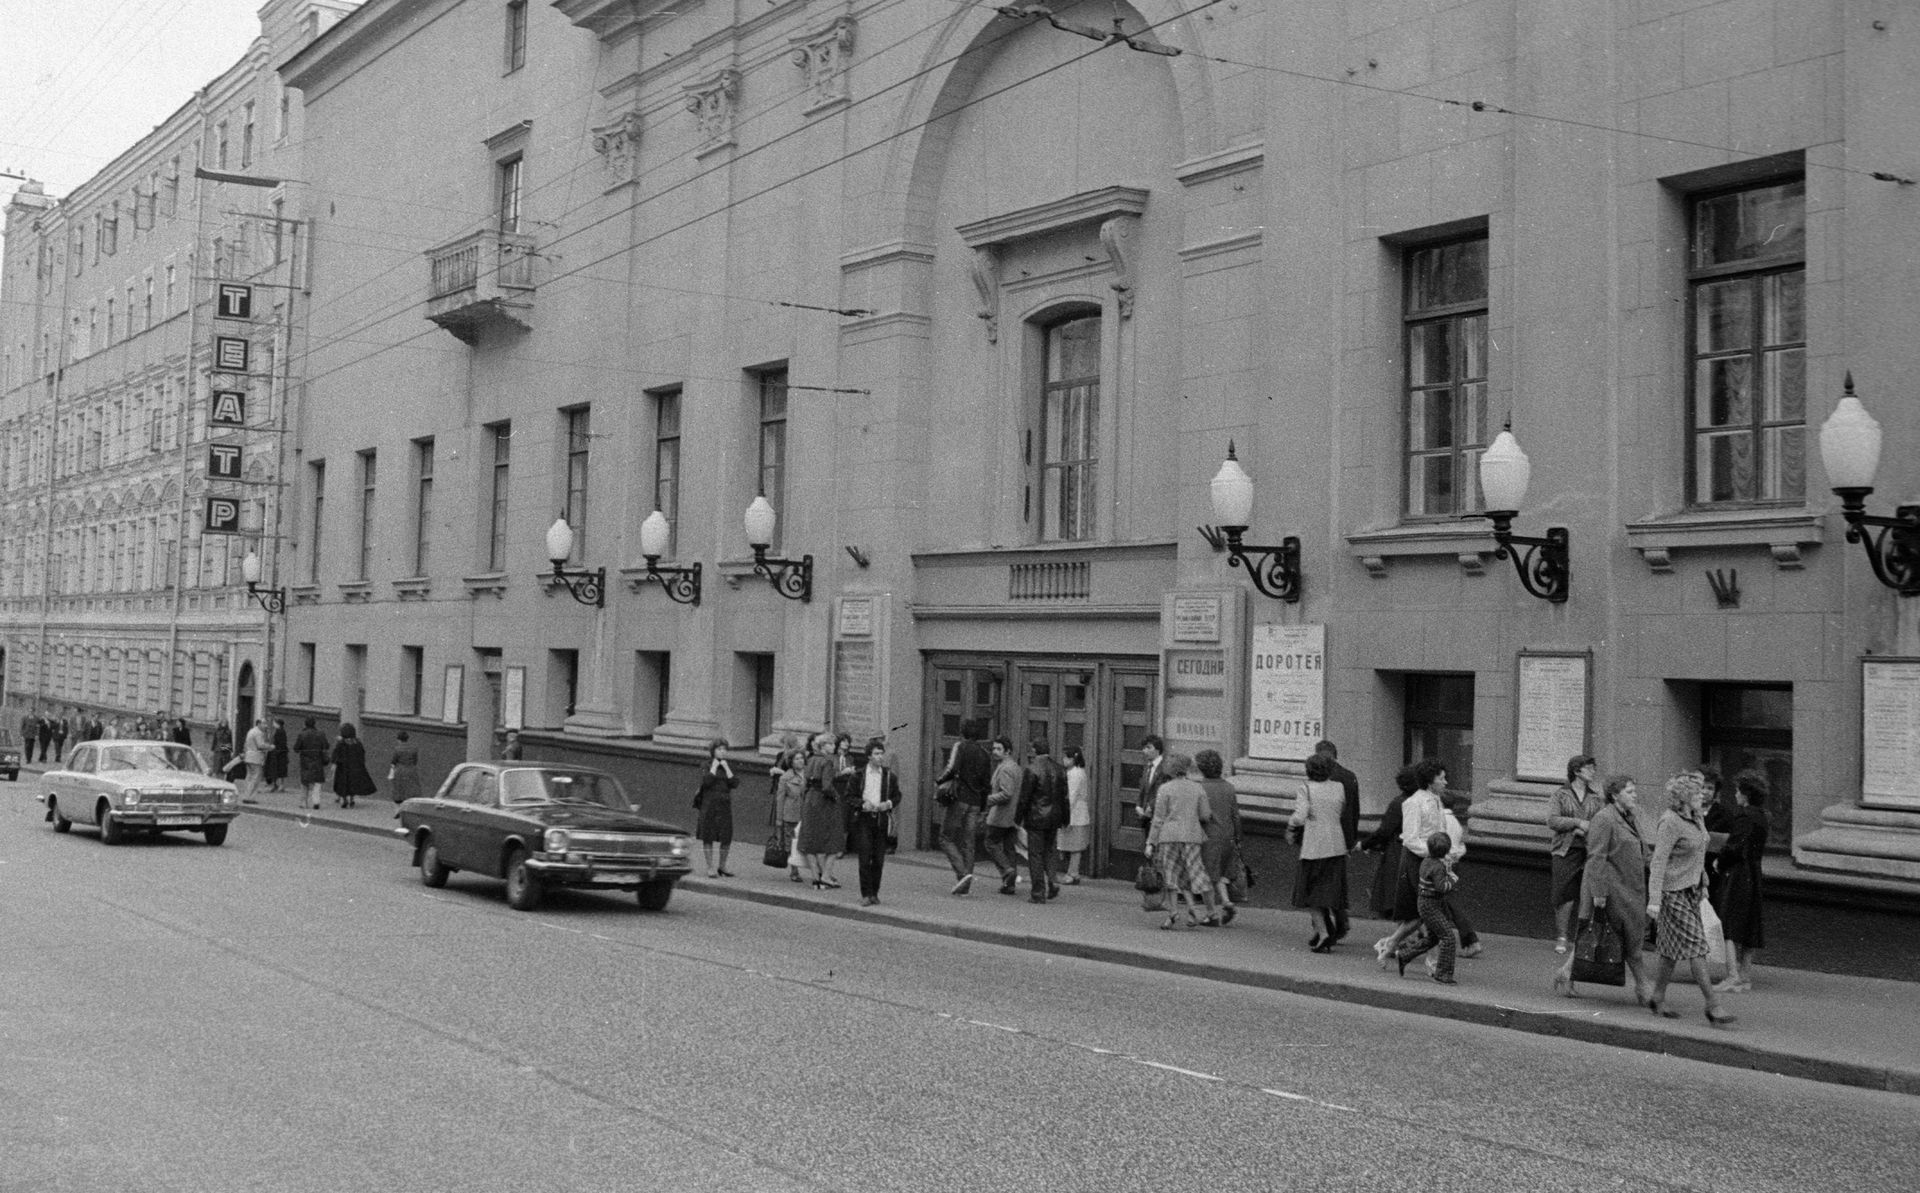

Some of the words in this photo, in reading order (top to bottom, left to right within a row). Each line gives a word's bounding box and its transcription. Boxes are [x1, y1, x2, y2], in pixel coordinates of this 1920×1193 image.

[211, 287, 248, 527] ТЕАТР
[1177, 659, 1224, 676] СЕГОДНЯ
[1255, 654, 1322, 670] ДОРОТЕЯ
[1253, 718, 1321, 737] ДОРОТЕЯ
